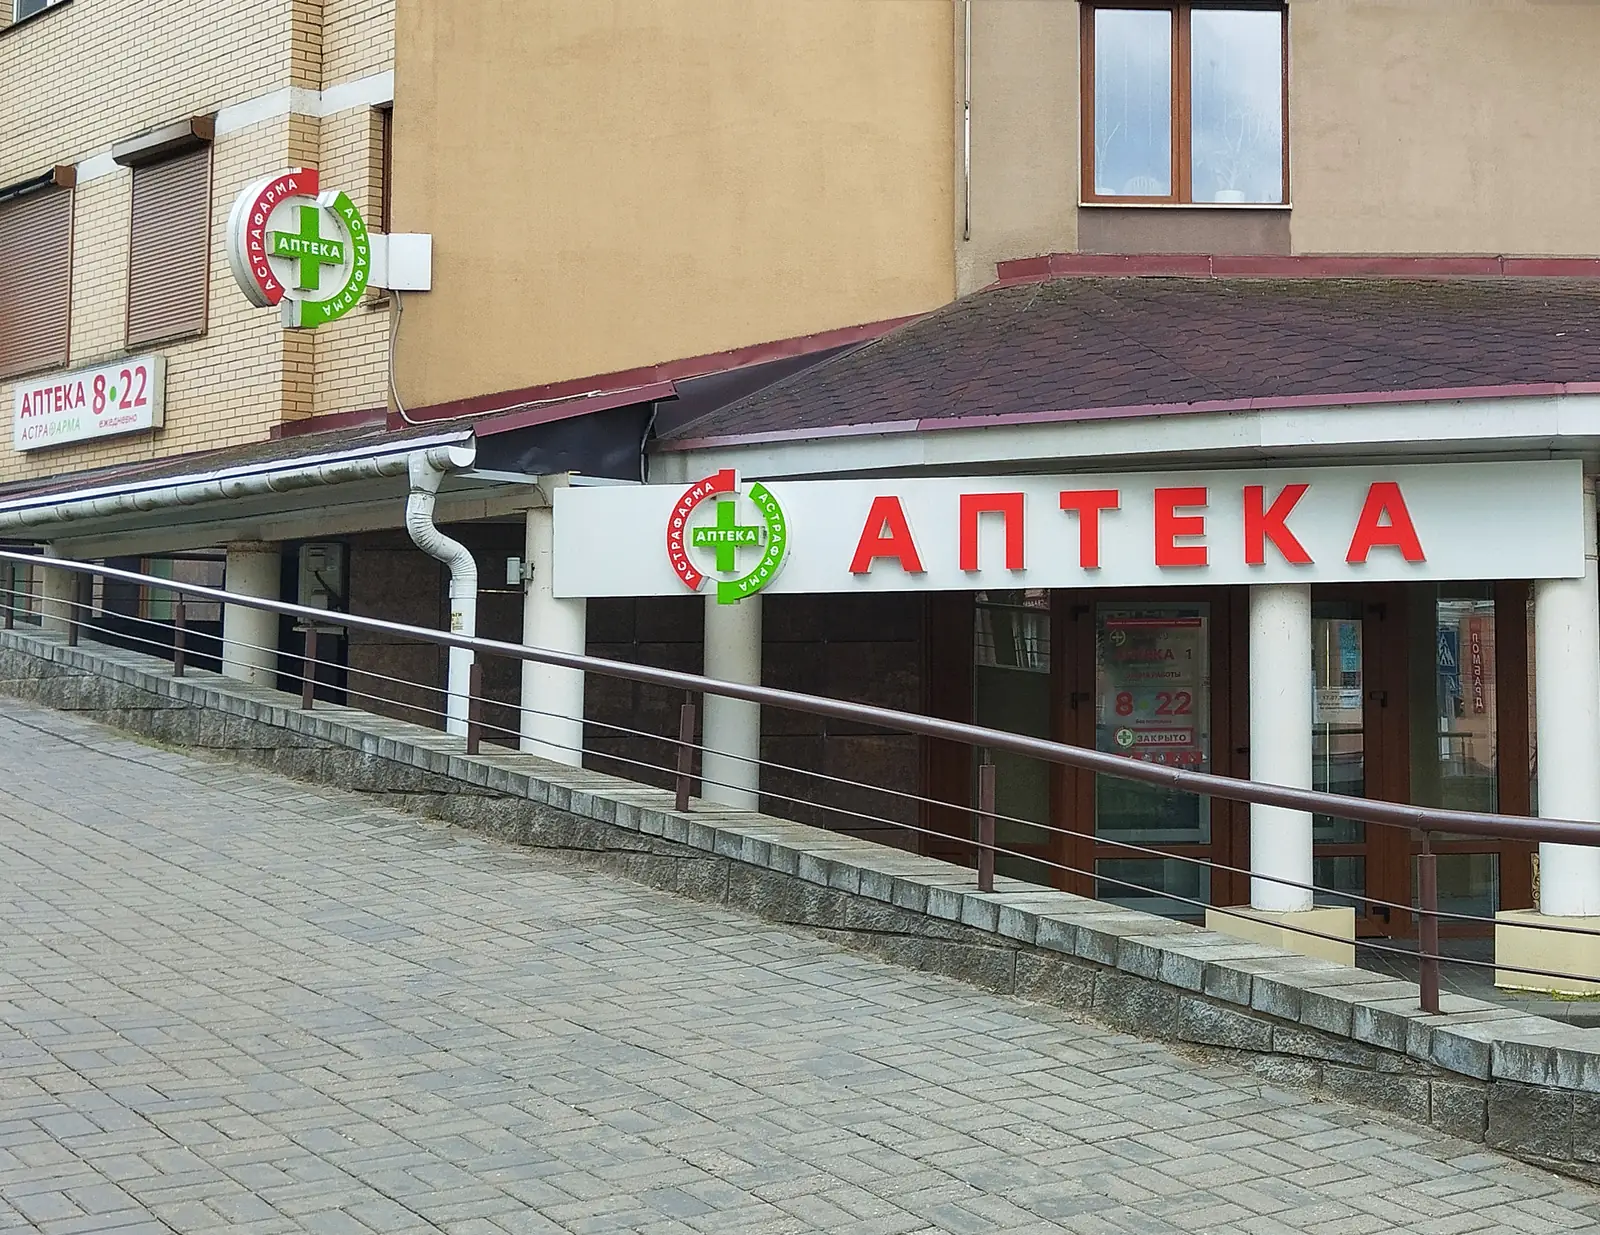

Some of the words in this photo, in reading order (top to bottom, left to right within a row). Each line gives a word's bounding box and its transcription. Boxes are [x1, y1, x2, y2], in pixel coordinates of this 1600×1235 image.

[251, 178, 298, 290] АСТРАФАРМА
[278, 237, 341, 259] АПТЕКА
[322, 207, 367, 316] АСТРАФАРМА
[20, 381, 86, 418] АПТЕКА
[671, 482, 714, 581] АСТРАФАРМА
[695, 530, 756, 542] АПТЕКА
[738, 493, 783, 592] АСТРАФАРМА
[848, 481, 1428, 575] АПТЕКА
[1136, 734, 1187, 742] ЗАКРЫТО
